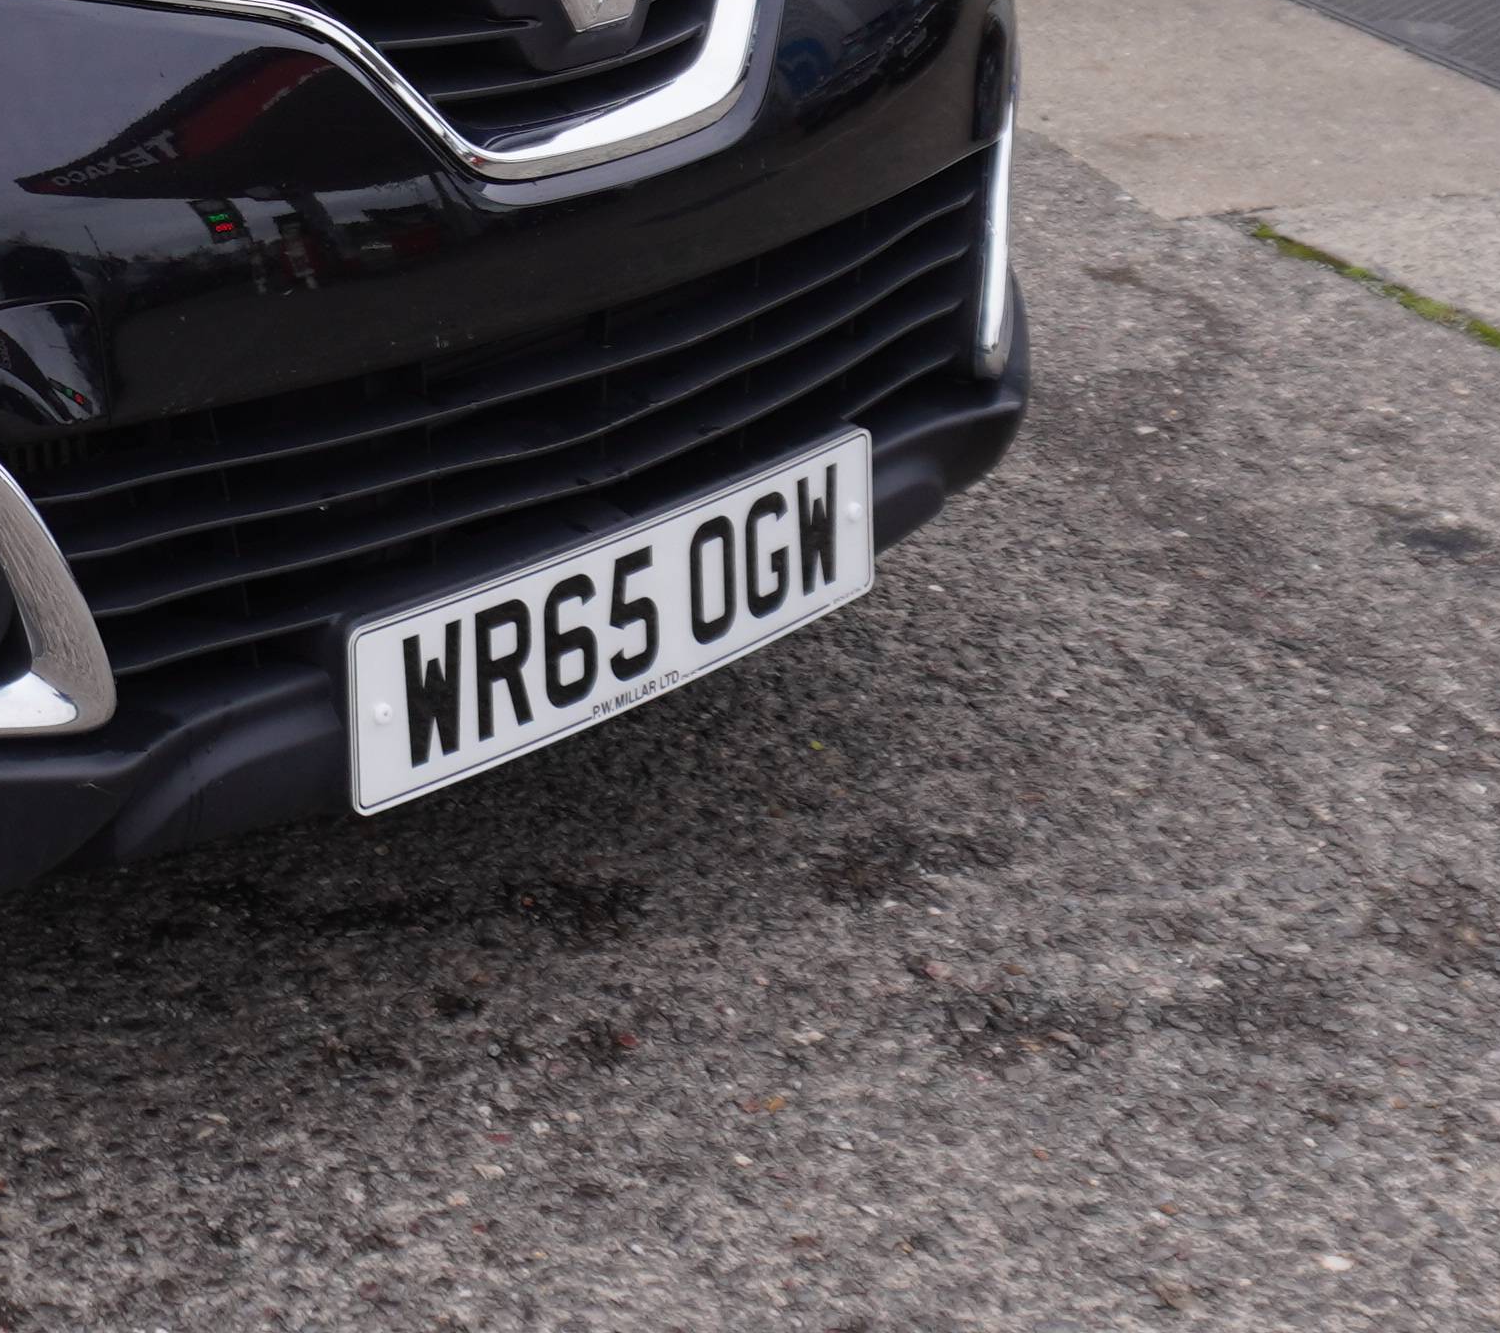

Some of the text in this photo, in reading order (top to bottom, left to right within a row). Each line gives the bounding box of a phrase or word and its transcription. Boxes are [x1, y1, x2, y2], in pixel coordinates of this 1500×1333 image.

[402, 463, 839, 770] WR65 OGW
[659, 670, 680, 690] LTD
